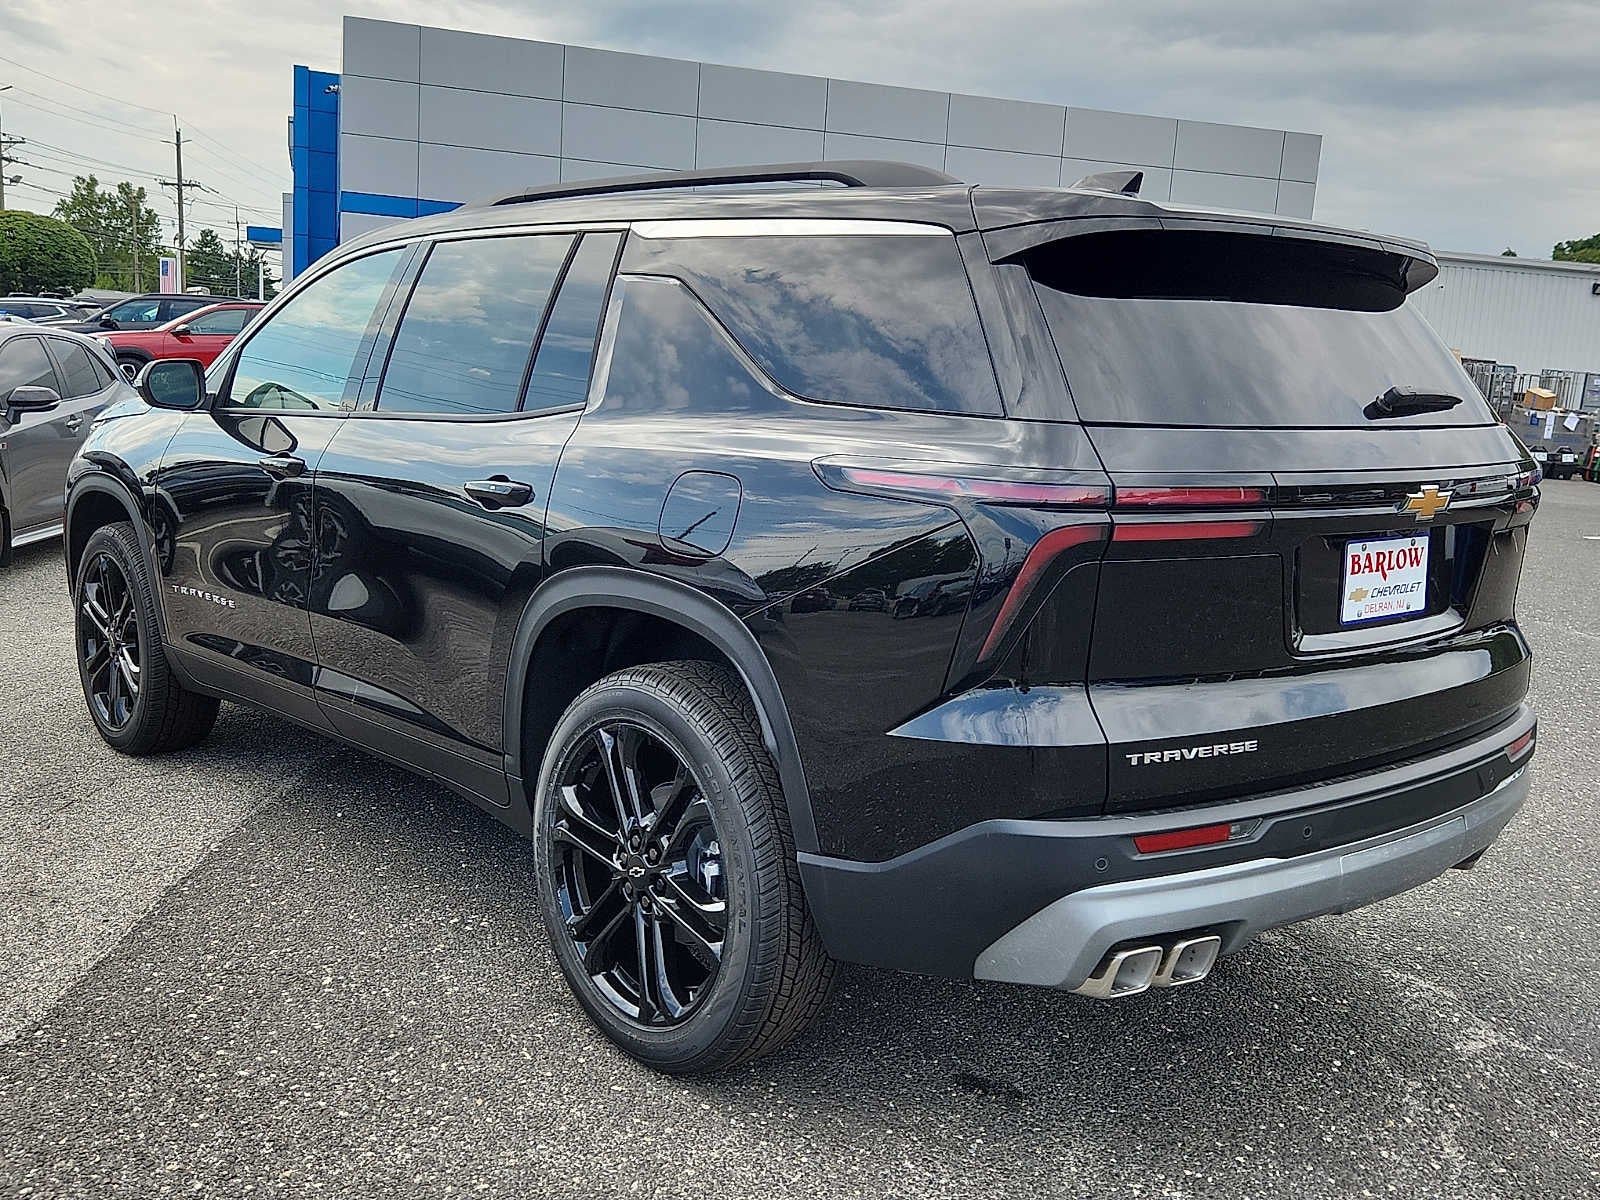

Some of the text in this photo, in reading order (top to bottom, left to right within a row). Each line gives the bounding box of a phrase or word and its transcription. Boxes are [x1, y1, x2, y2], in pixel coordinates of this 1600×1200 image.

[1350, 546, 1424, 582] BARLOW
[172, 585, 236, 609] TRAVERSE
[1371, 581, 1423, 598] CHEVROLET
[1396, 599, 1405, 609] NJ
[1125, 739, 1258, 766] TRAVERSE
